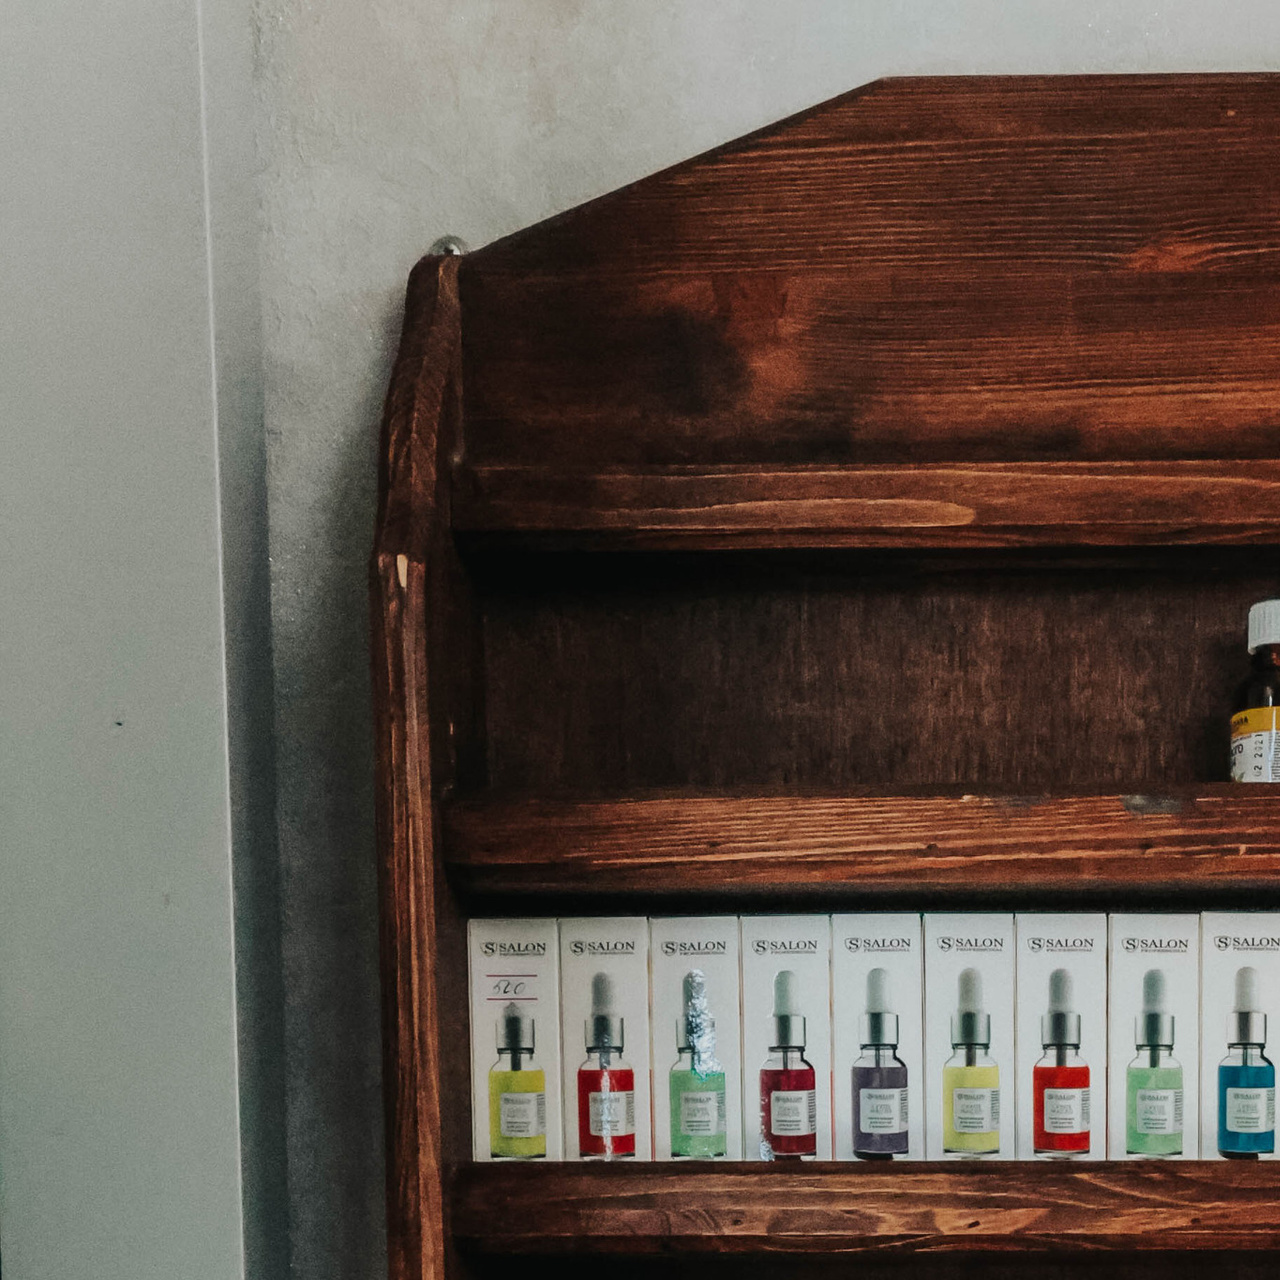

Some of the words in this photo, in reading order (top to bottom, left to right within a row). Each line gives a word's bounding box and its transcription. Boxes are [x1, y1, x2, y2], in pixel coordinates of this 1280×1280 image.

[499, 942, 546, 952] SALON
[588, 940, 635, 951] SALON
[679, 941, 726, 951] SALON
[771, 940, 818, 950] SALON
[863, 938, 911, 948] SALON
[956, 937, 1003, 948] SALON
[1046, 938, 1094, 948] SALON
[1141, 938, 1189, 949] SALON
[1232, 937, 1280, 947] SALON
